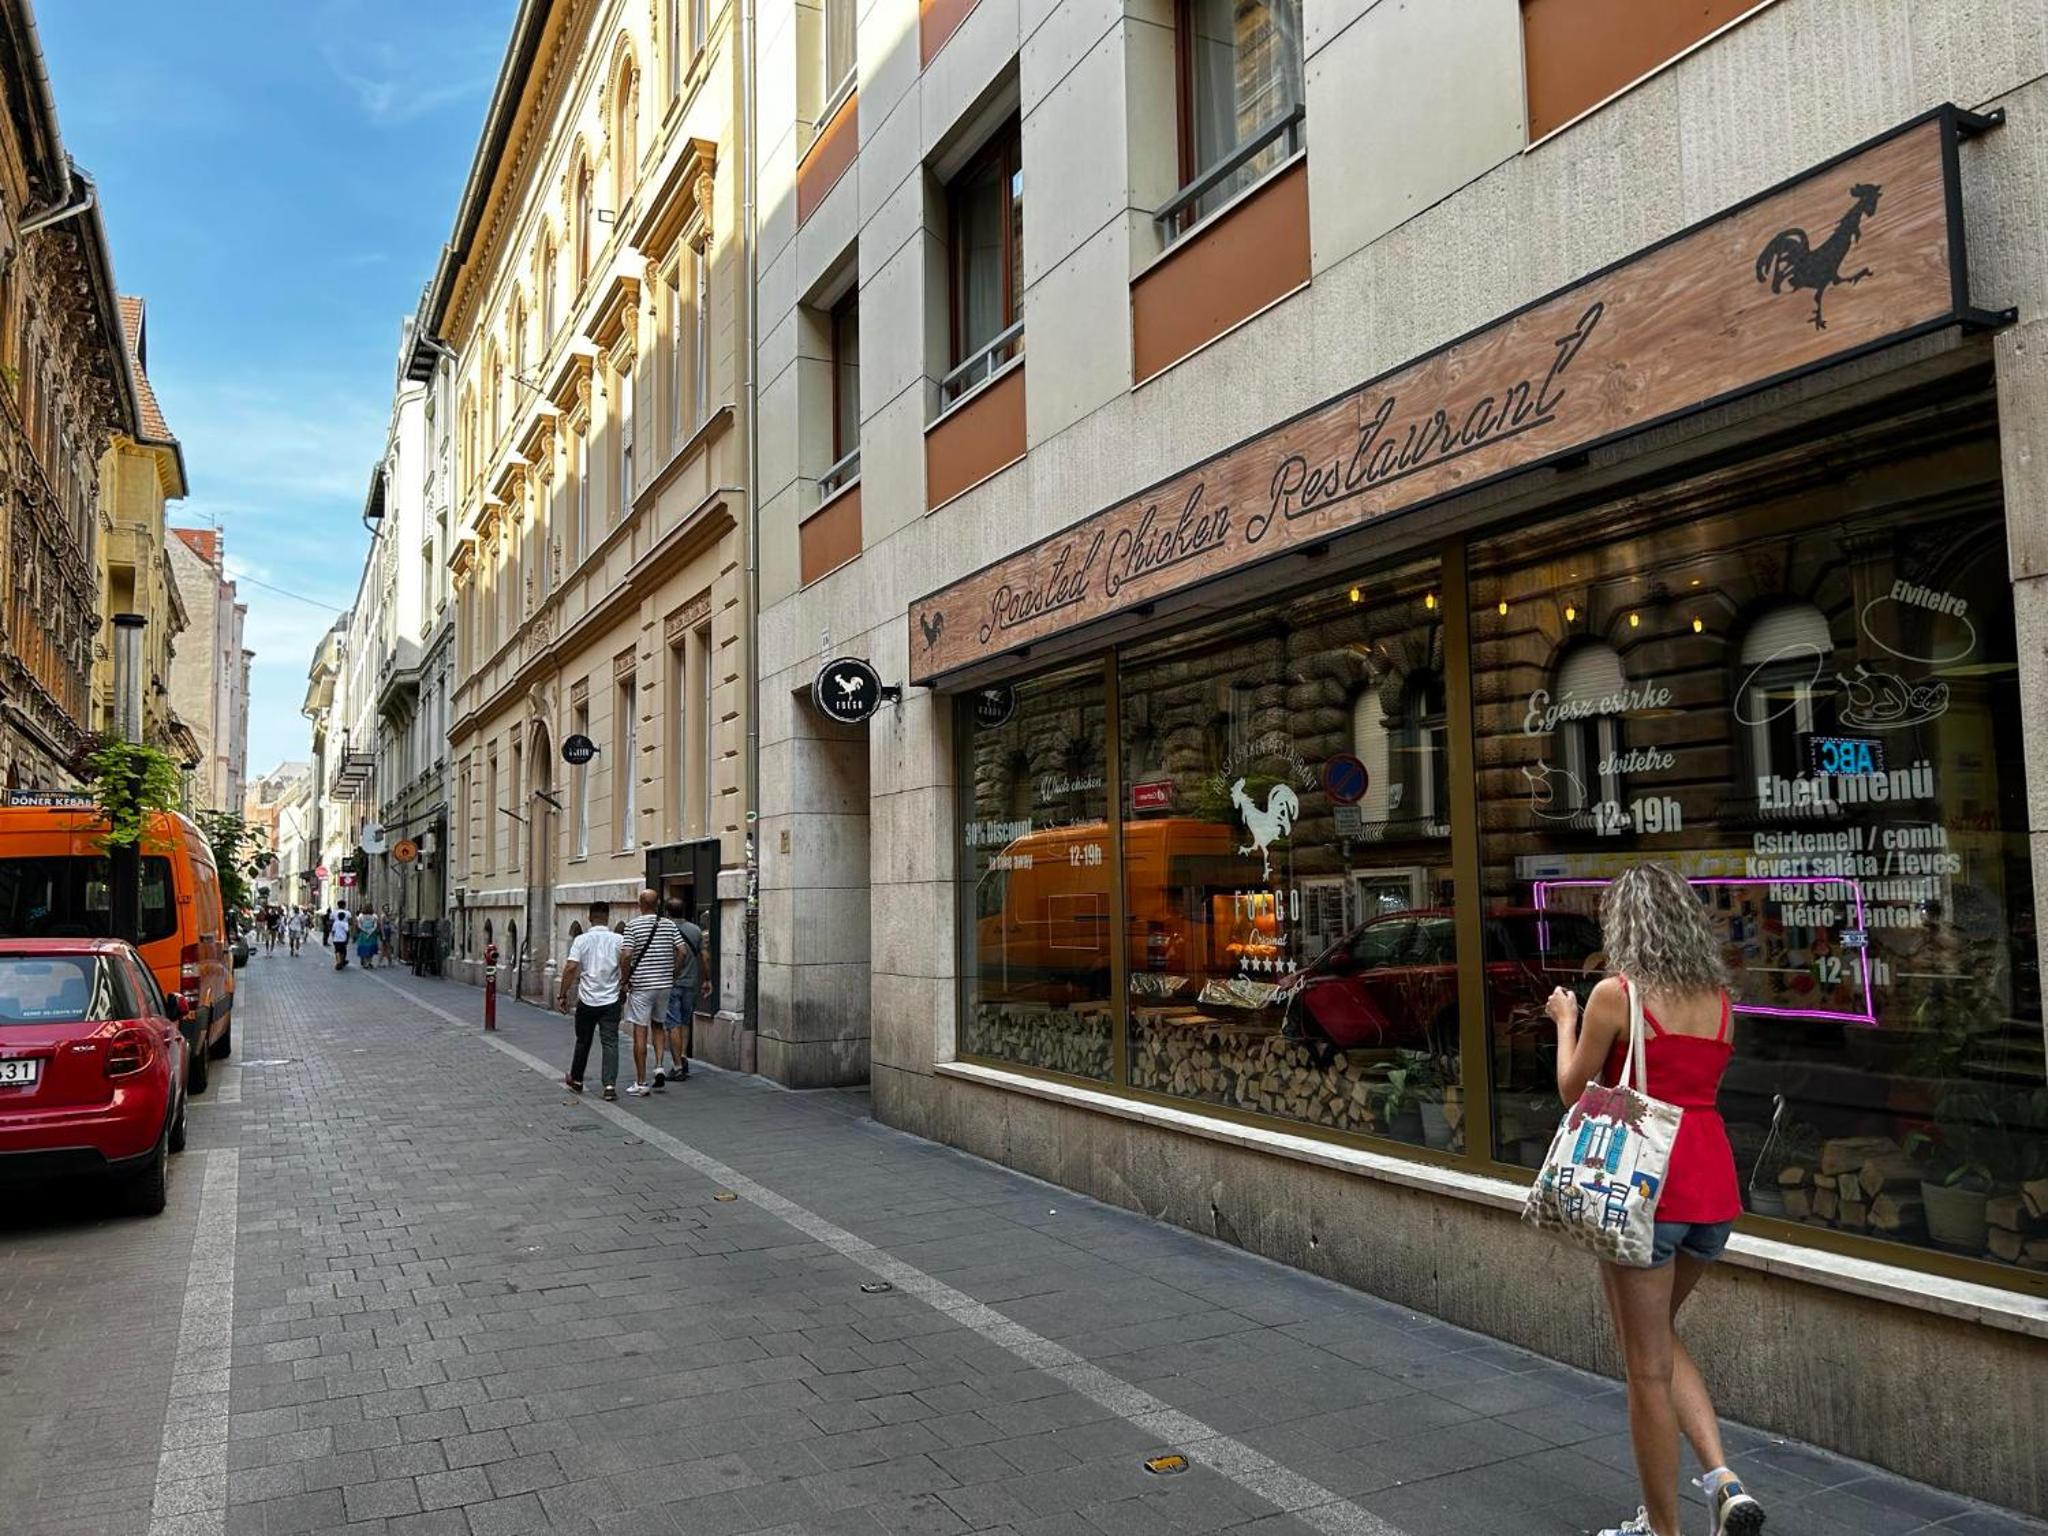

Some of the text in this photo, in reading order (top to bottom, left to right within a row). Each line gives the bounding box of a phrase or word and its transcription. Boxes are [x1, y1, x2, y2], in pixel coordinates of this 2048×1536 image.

[980, 302, 1604, 643] Roasted Chicken Restaurant
[1890, 579, 1968, 617] Elvitelre
[1523, 680, 1672, 737] Egész csirke
[1598, 746, 1675, 776] elvitelre
[1071, 774, 1102, 791] chicken
[1758, 760, 1935, 809] Ebéd menü
[11, 794, 91, 806] DÖNER KEBAB
[1591, 796, 1682, 836] 12-19h
[965, 817, 1032, 846] 30% Discount
[1753, 823, 1948, 855] Csirkemell / comb
[1013, 854, 1032, 870] away
[1070, 844, 1102, 867] 12-19h
[1745, 850, 1961, 878] Kevert saláta / leves
[1235, 889, 1299, 921] FUEGO
[1846, 902, 1923, 928] Péntek
[0, 1063, 29, 1079] 31
